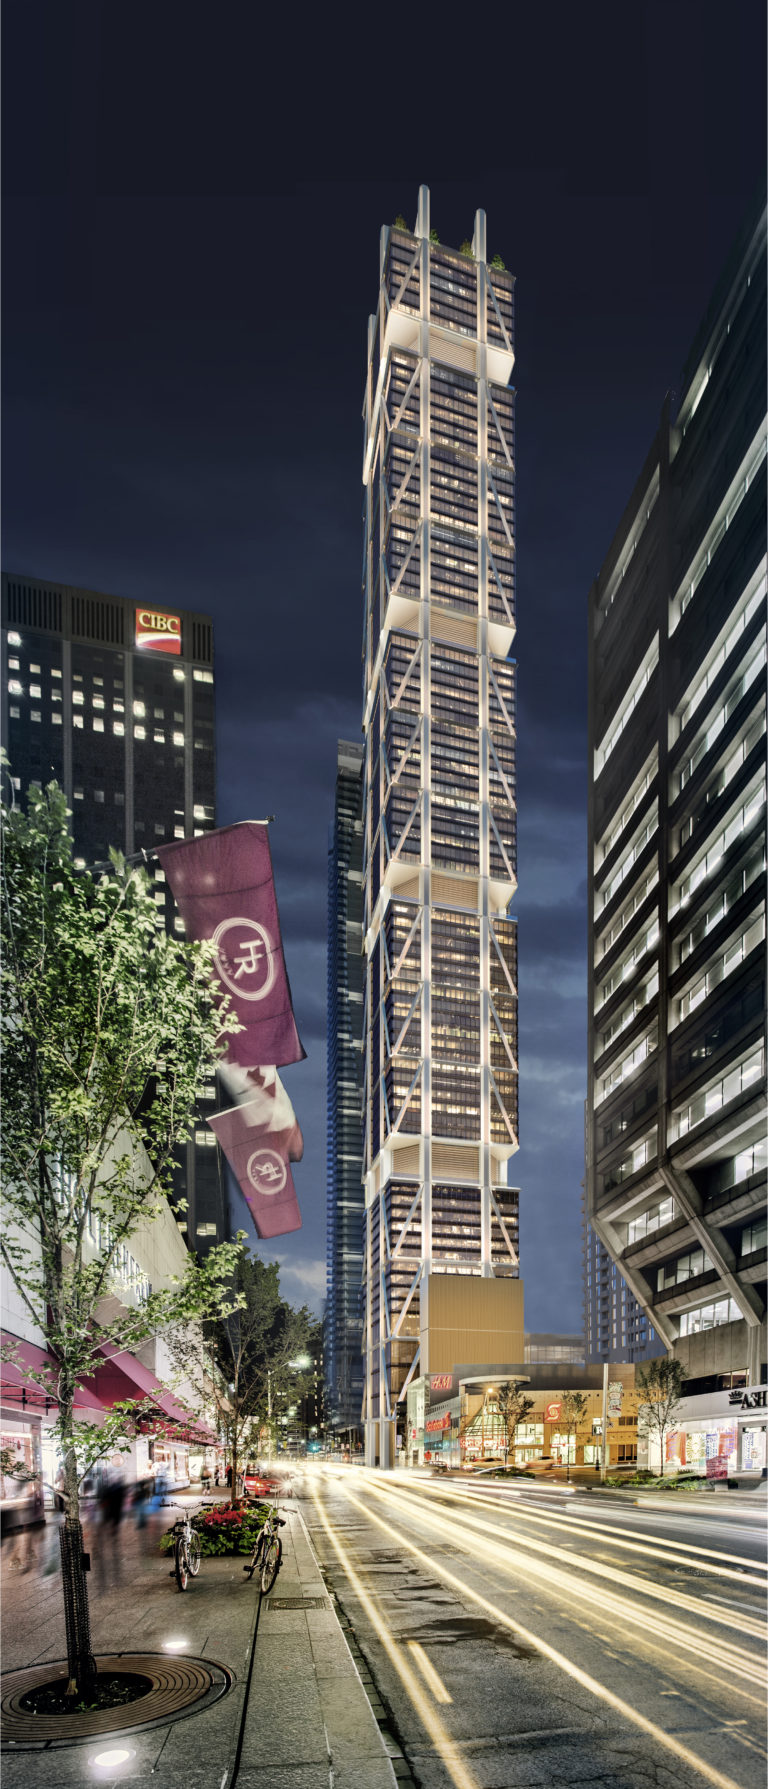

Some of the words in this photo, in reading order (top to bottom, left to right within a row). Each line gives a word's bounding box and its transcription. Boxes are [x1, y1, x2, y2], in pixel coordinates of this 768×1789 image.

[138, 612, 179, 634] CIBC
[234, 940, 264, 979] HR
[431, 1375, 452, 1389] H&M
